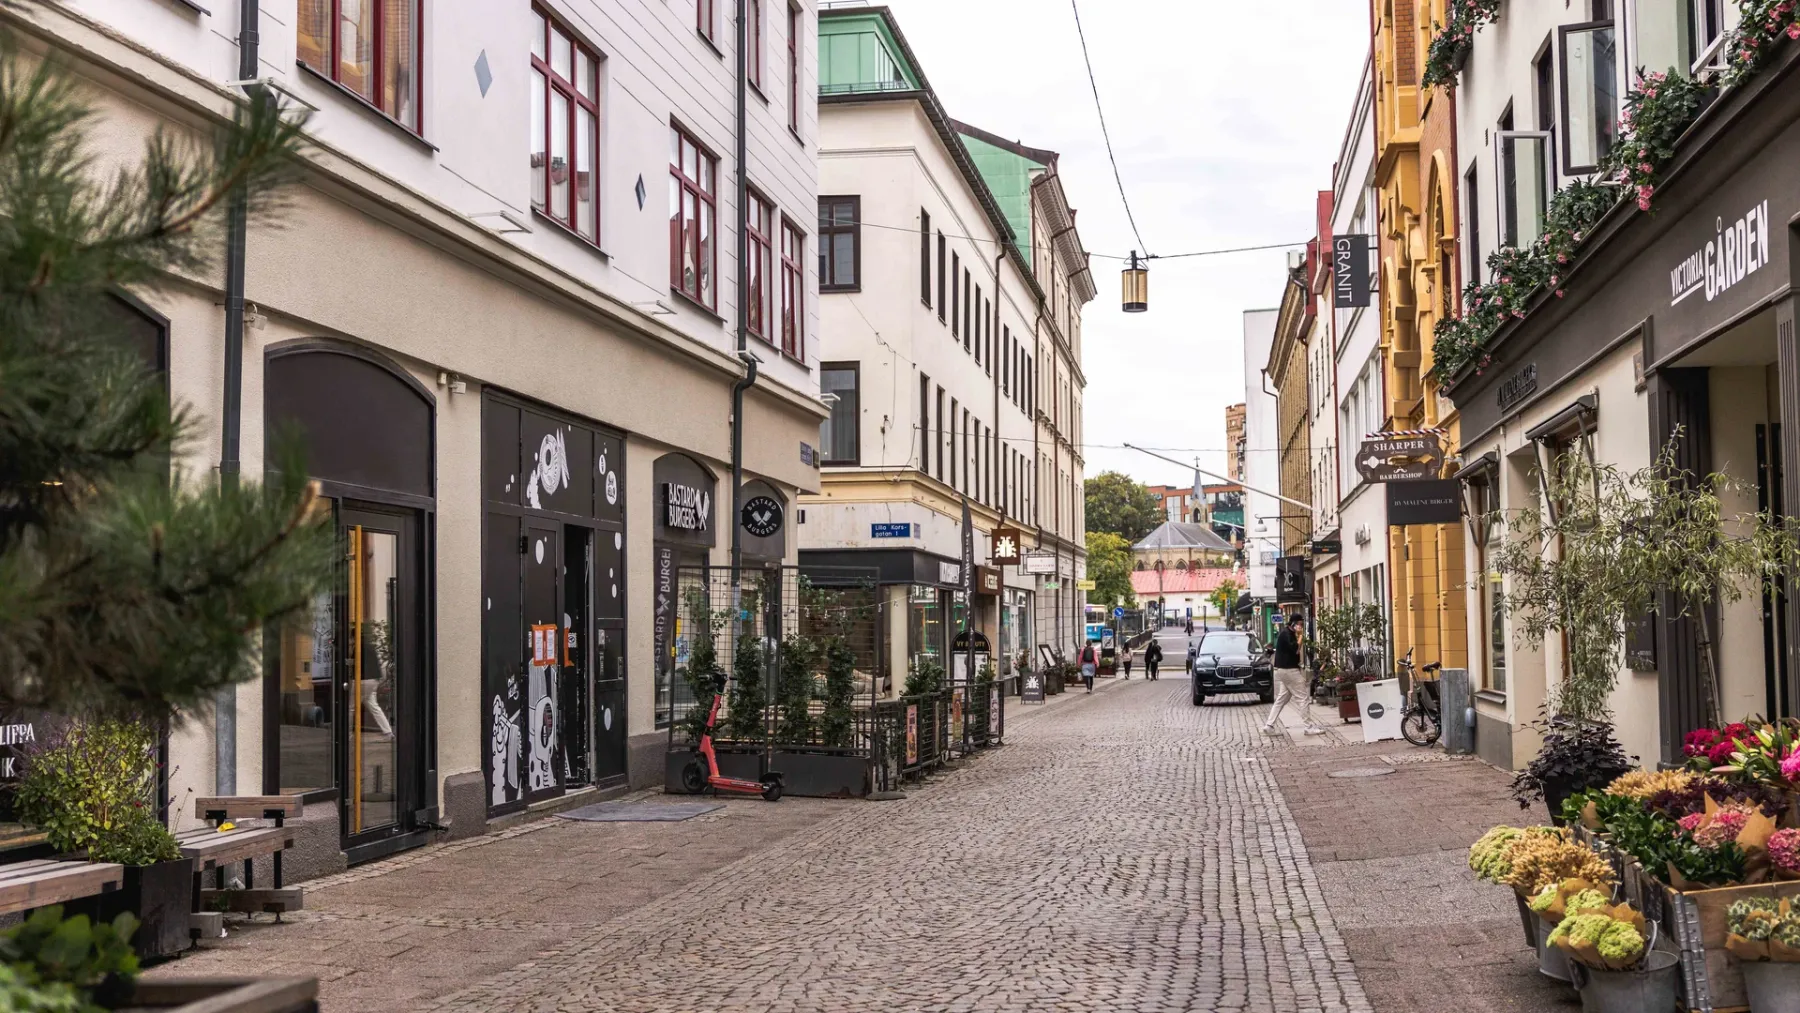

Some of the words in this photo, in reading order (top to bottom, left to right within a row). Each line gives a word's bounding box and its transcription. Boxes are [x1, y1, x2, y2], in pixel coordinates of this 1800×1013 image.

[1670, 249, 1704, 297] VICTORIA
[1704, 199, 1769, 302] GÅRDEN
[1337, 238, 1352, 303] GRANIT
[1373, 440, 1425, 451] SHARPER
[1379, 472, 1422, 480] BARBERSHOP
[669, 482, 696, 508] BASTARD
[747, 498, 777, 510] BASTARD
[668, 504, 696, 530] BURGERS
[747, 523, 777, 535] BURGERS
